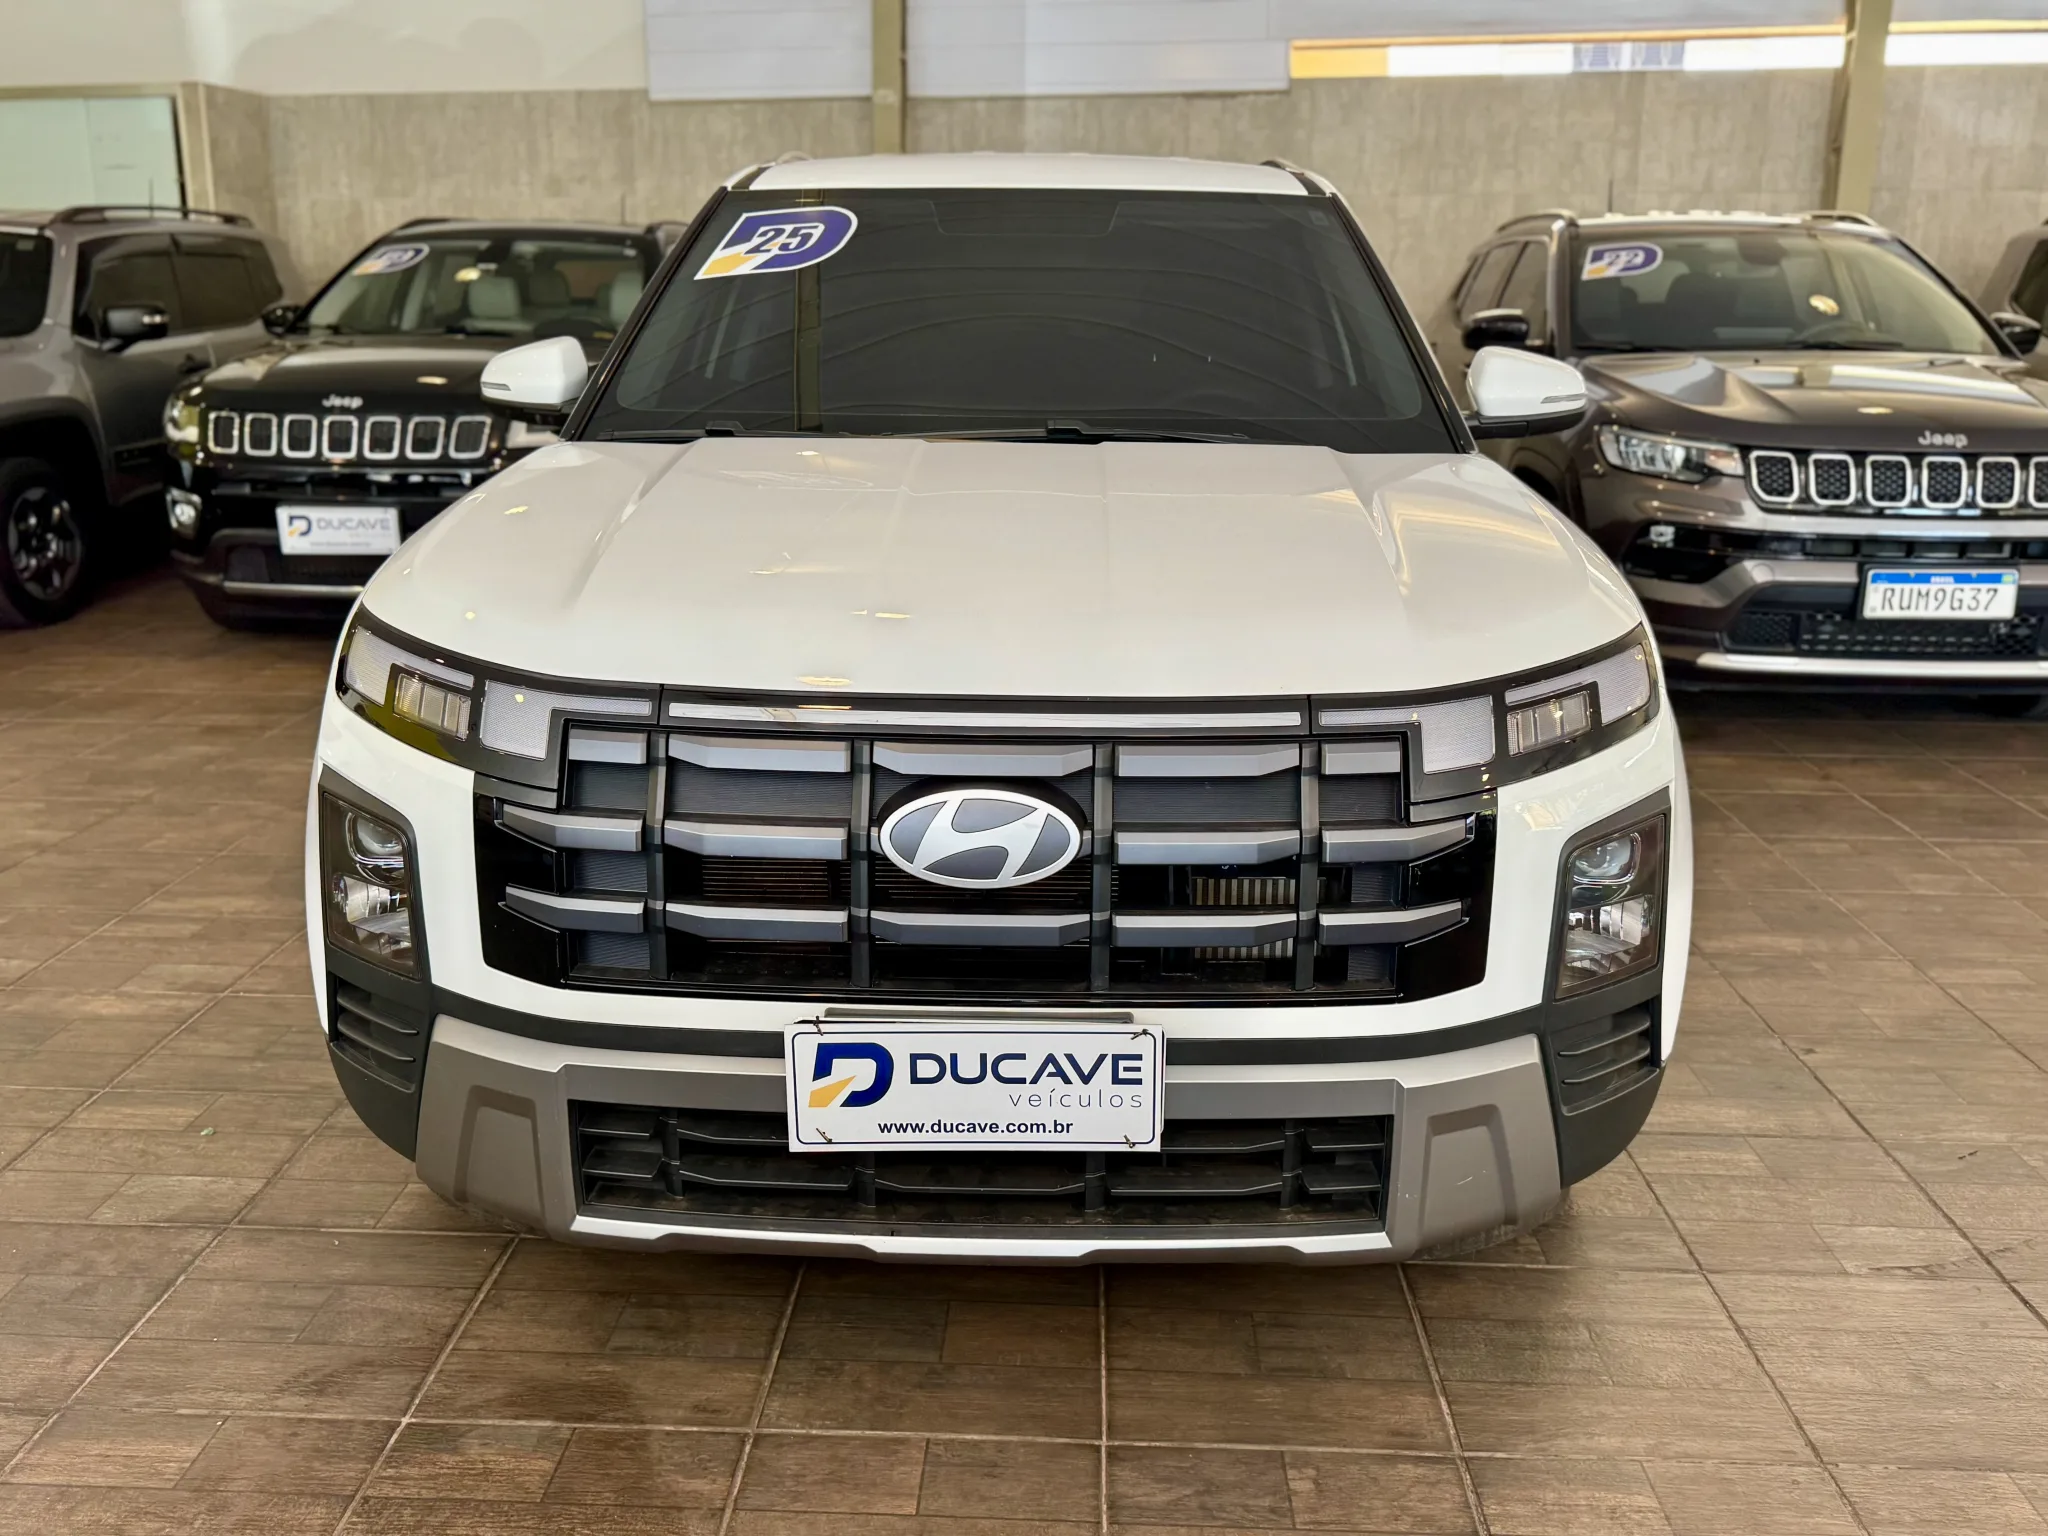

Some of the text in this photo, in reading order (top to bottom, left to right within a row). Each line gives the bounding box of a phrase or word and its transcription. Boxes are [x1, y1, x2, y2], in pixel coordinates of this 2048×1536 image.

[743, 225, 819, 255] 25
[322, 394, 363, 410] Jeep
[1917, 430, 1968, 449] Jeep
[1881, 587, 1998, 612] RUM9G37
[909, 1052, 1143, 1085] DUCAVE
[1009, 1088, 1142, 1108] veículos
[877, 1119, 1073, 1135] www.ducave.com.br
